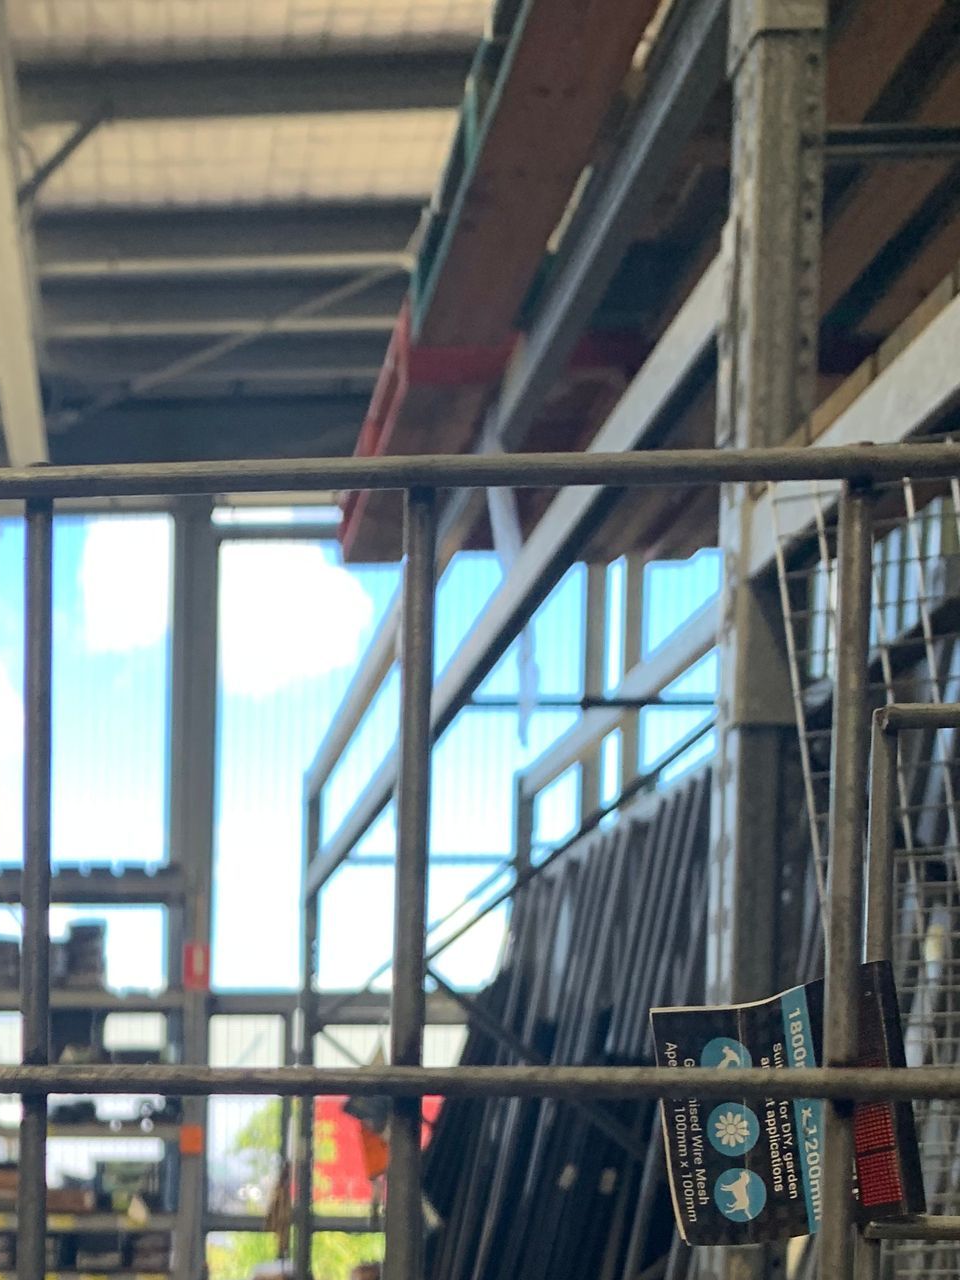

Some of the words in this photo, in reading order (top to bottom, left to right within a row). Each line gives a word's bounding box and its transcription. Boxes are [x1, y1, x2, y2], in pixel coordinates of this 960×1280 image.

[779, 1100, 790, 1119] for
[691, 1134, 704, 1165] Wire
[765, 1109, 784, 1192] applications
[781, 1123, 793, 1149] DIY,
[673, 1106, 688, 1157] 100mm
[682, 1172, 698, 1222] 100mm
[782, 1151, 799, 1199] garden
[695, 1168, 710, 1205] Mesh
